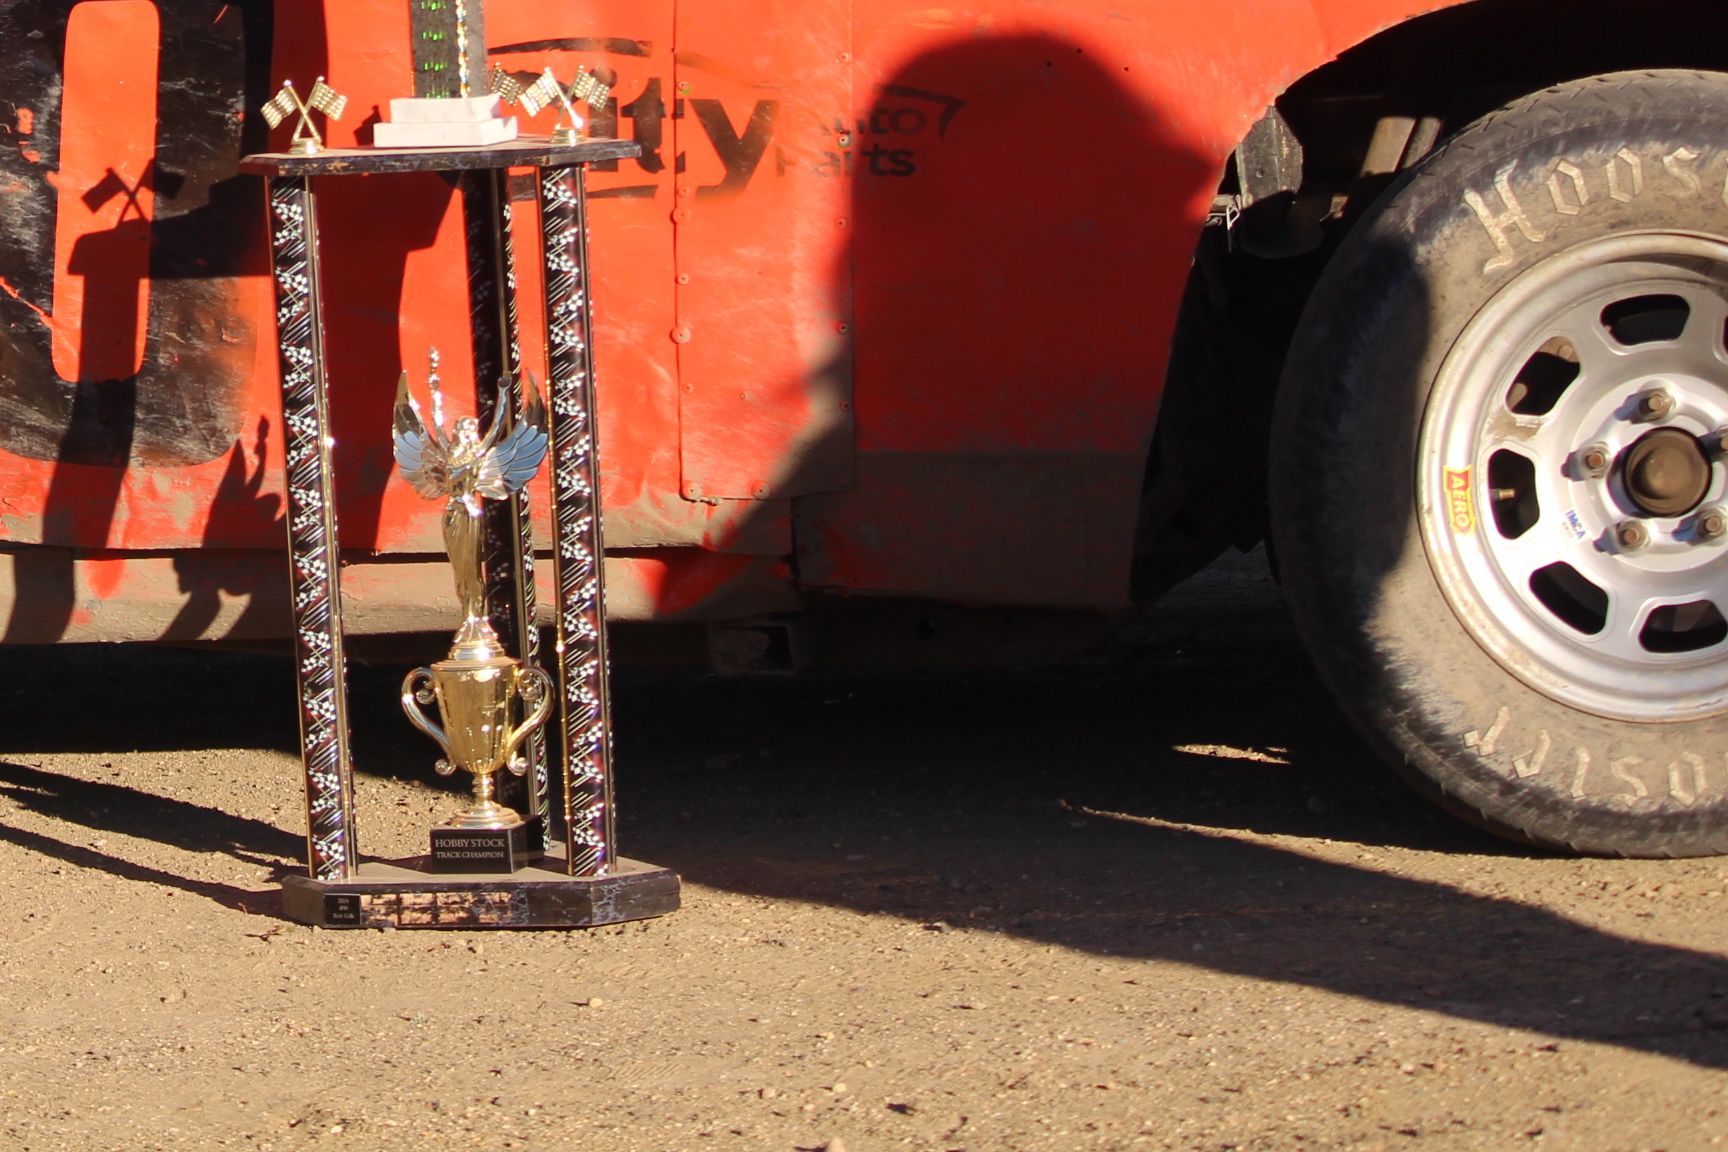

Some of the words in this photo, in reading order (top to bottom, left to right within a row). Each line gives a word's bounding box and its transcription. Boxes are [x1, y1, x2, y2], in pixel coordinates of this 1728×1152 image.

[1463, 147, 1728, 275] Hoos
[1450, 475, 1470, 528] AERO
[435, 838, 469, 848] HOBBY
[471, 838, 505, 848] STOCK
[436, 851, 461, 859] TRACK
[461, 851, 504, 859] CHAMPION
